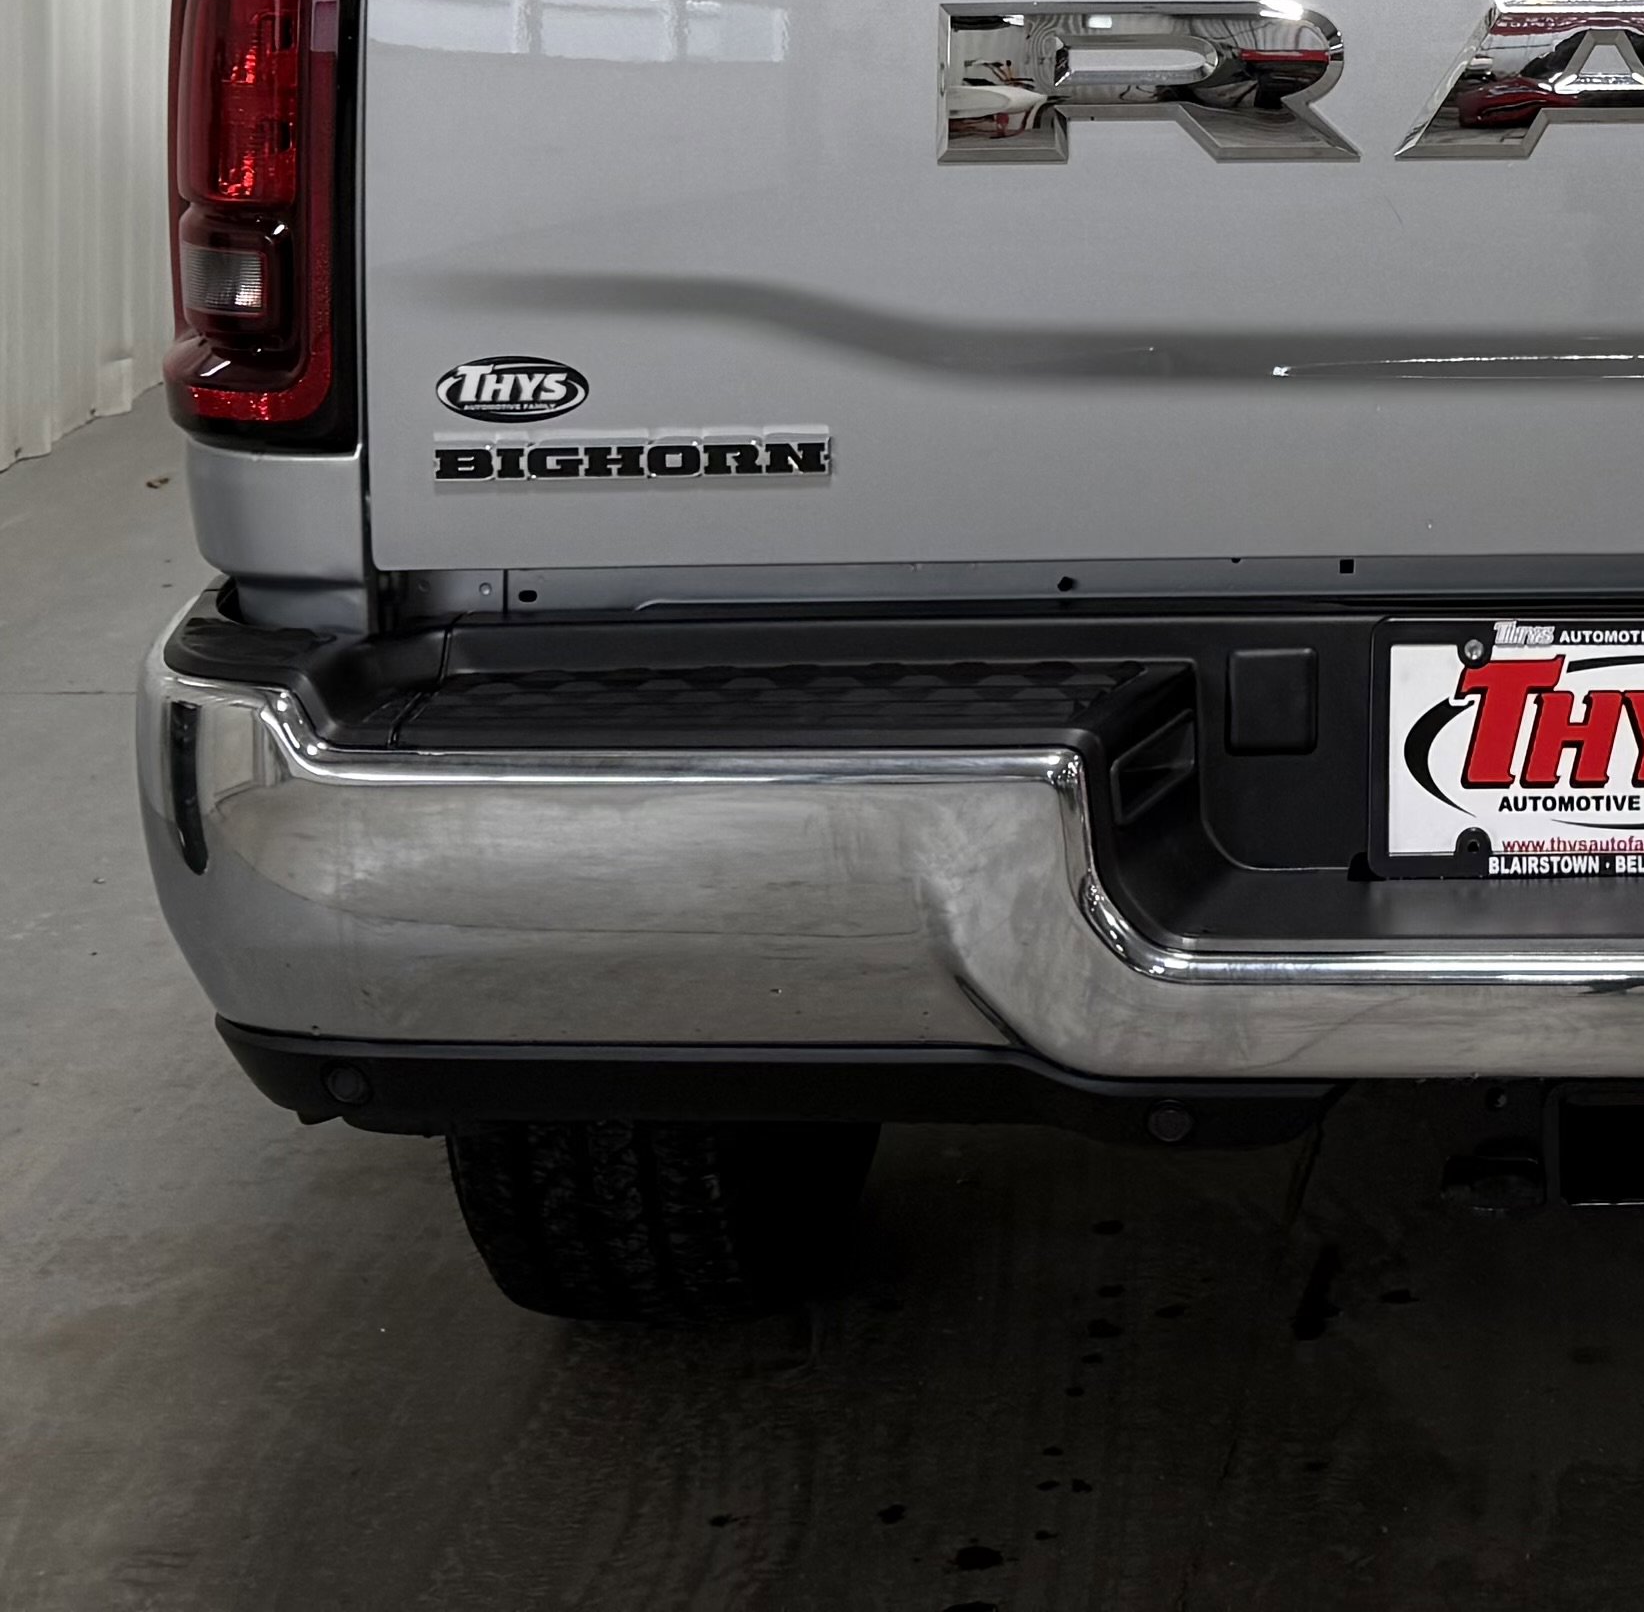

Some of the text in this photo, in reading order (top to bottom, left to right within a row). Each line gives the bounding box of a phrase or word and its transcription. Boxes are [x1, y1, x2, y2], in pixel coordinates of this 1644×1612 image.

[456, 364, 568, 402] THYS
[434, 440, 830, 481] BIGHORN
[1498, 795, 1641, 813] AUTOMOTIVE
[1488, 855, 1599, 875] BLAIRSTOWN
